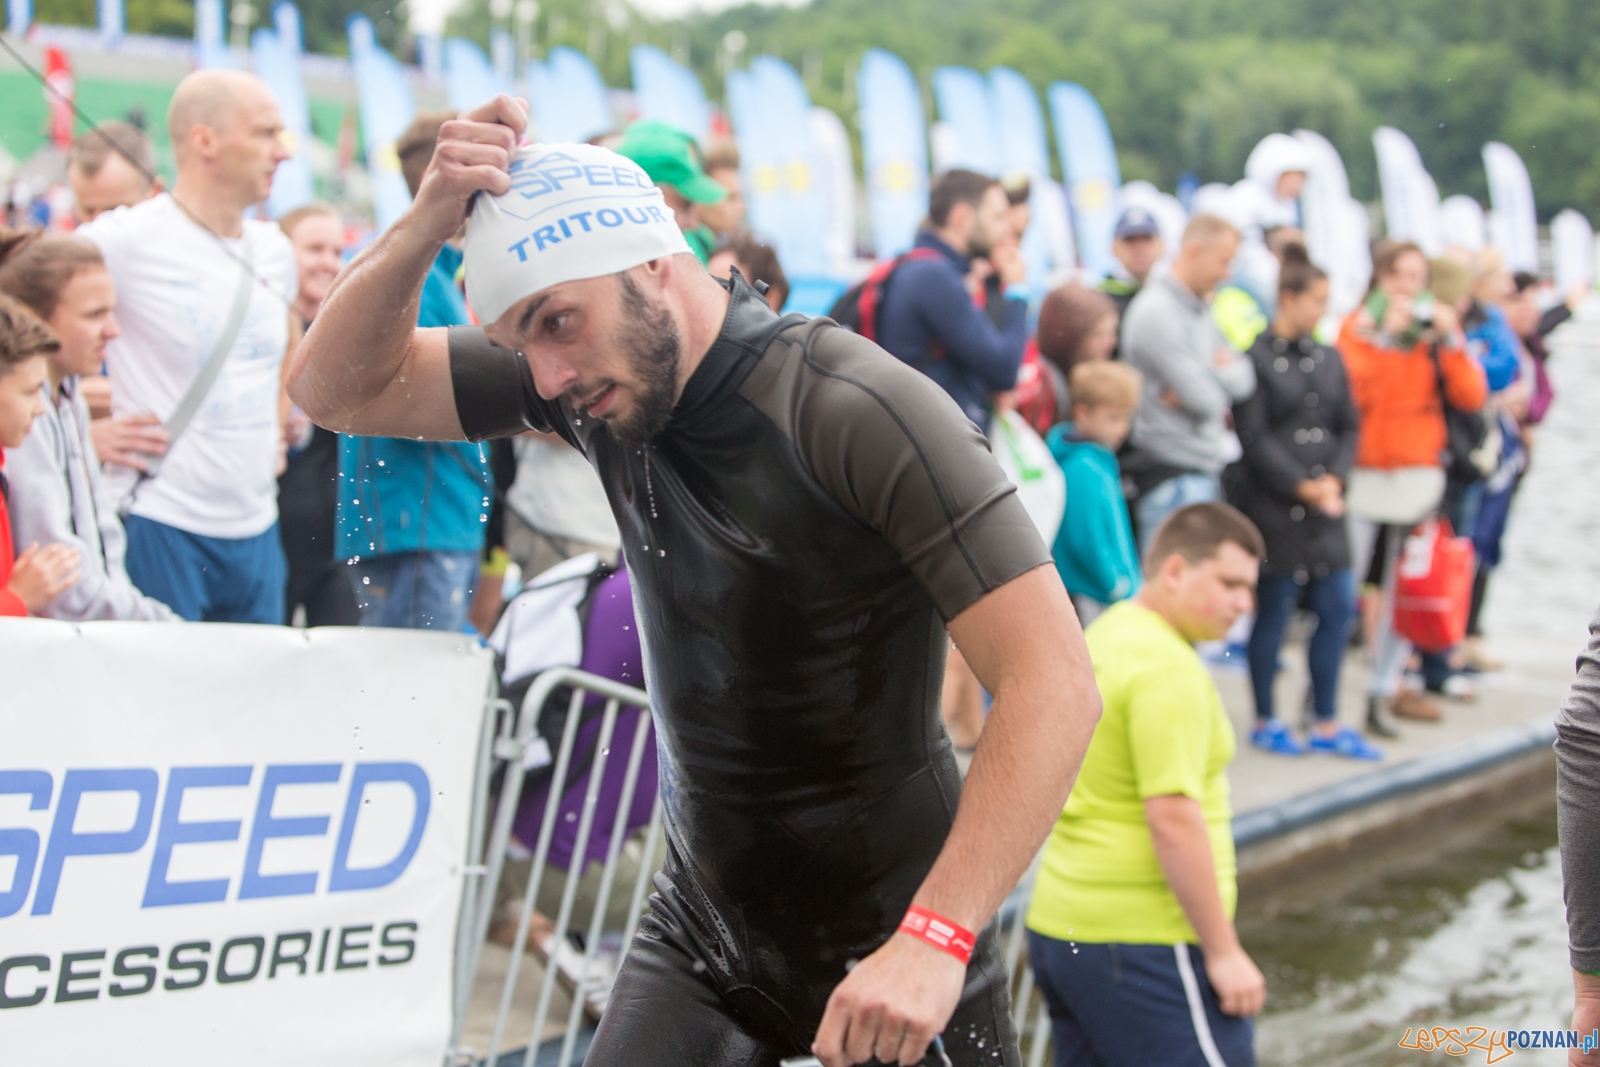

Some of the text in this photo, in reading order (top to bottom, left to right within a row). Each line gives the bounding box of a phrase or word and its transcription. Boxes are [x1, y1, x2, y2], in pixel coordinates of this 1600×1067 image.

[511, 165, 655, 199] SPEED
[508, 206, 667, 263] TRITOUR
[0, 761, 431, 919] SPEED
[0, 921, 418, 1009] CESSORIES
